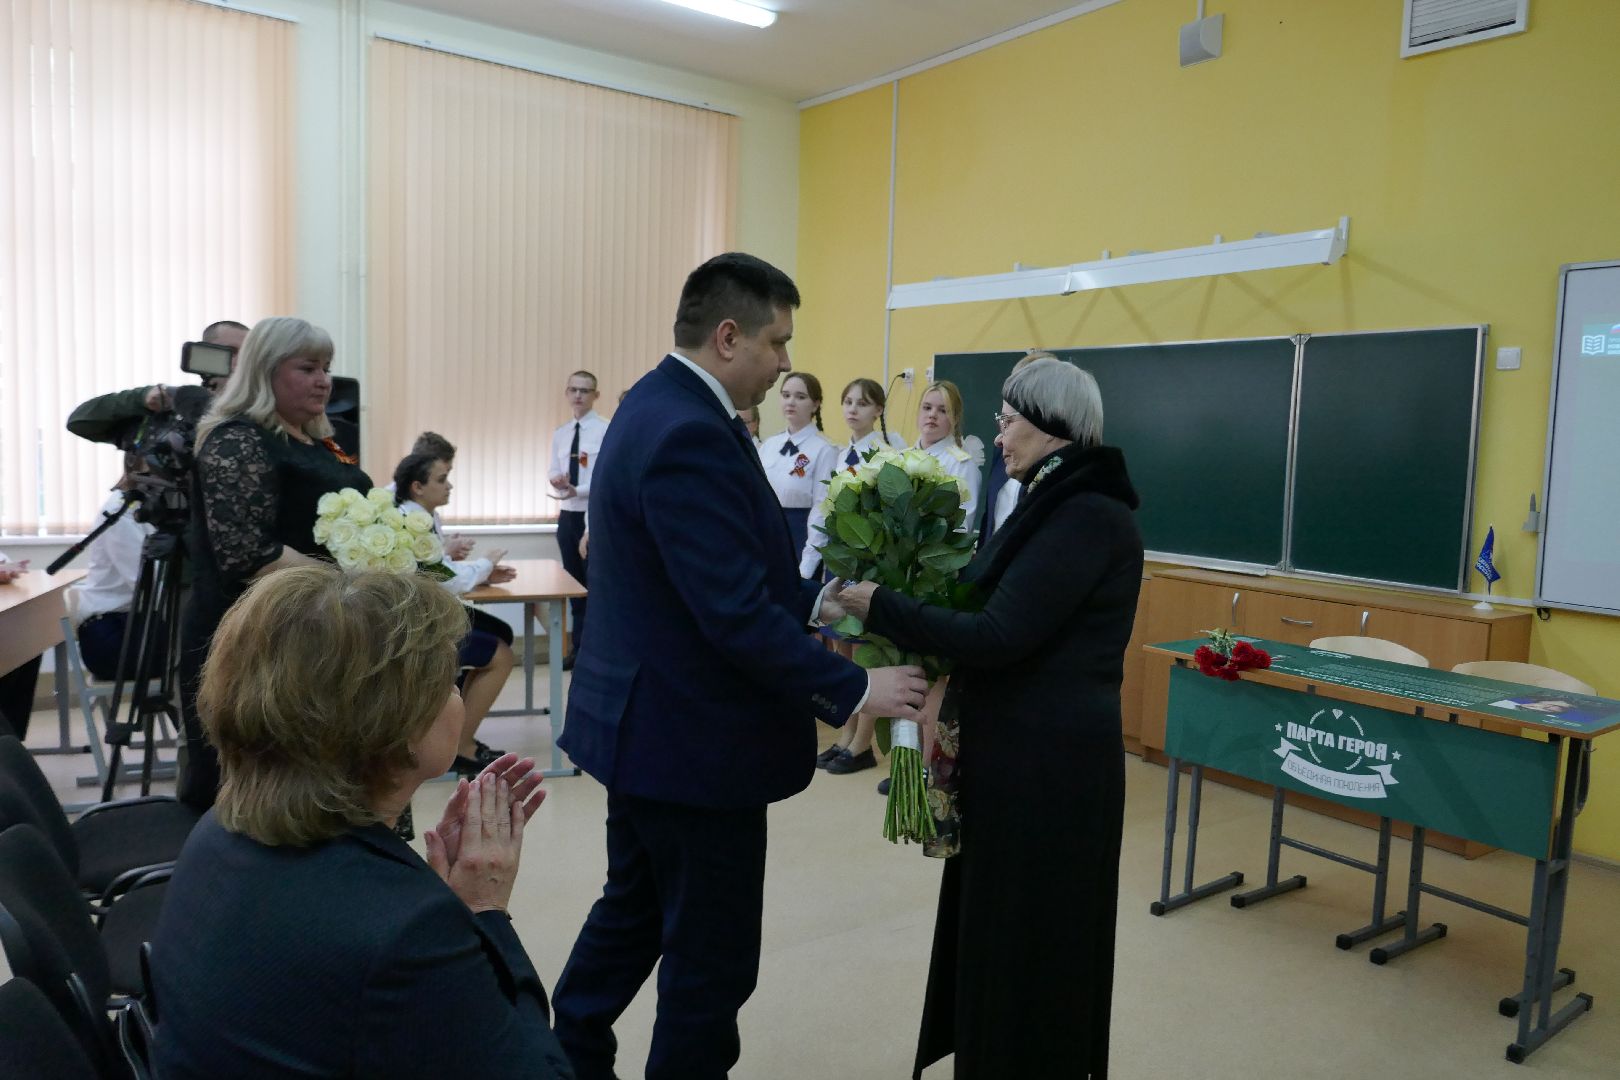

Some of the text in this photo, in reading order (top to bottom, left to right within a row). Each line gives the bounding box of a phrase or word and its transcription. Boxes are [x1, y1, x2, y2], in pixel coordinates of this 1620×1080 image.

[1286, 722, 1388, 761] ПАРТА ГЕРОЯ
[1333, 778, 1380, 793] ПОКОЛЕНИЯ
